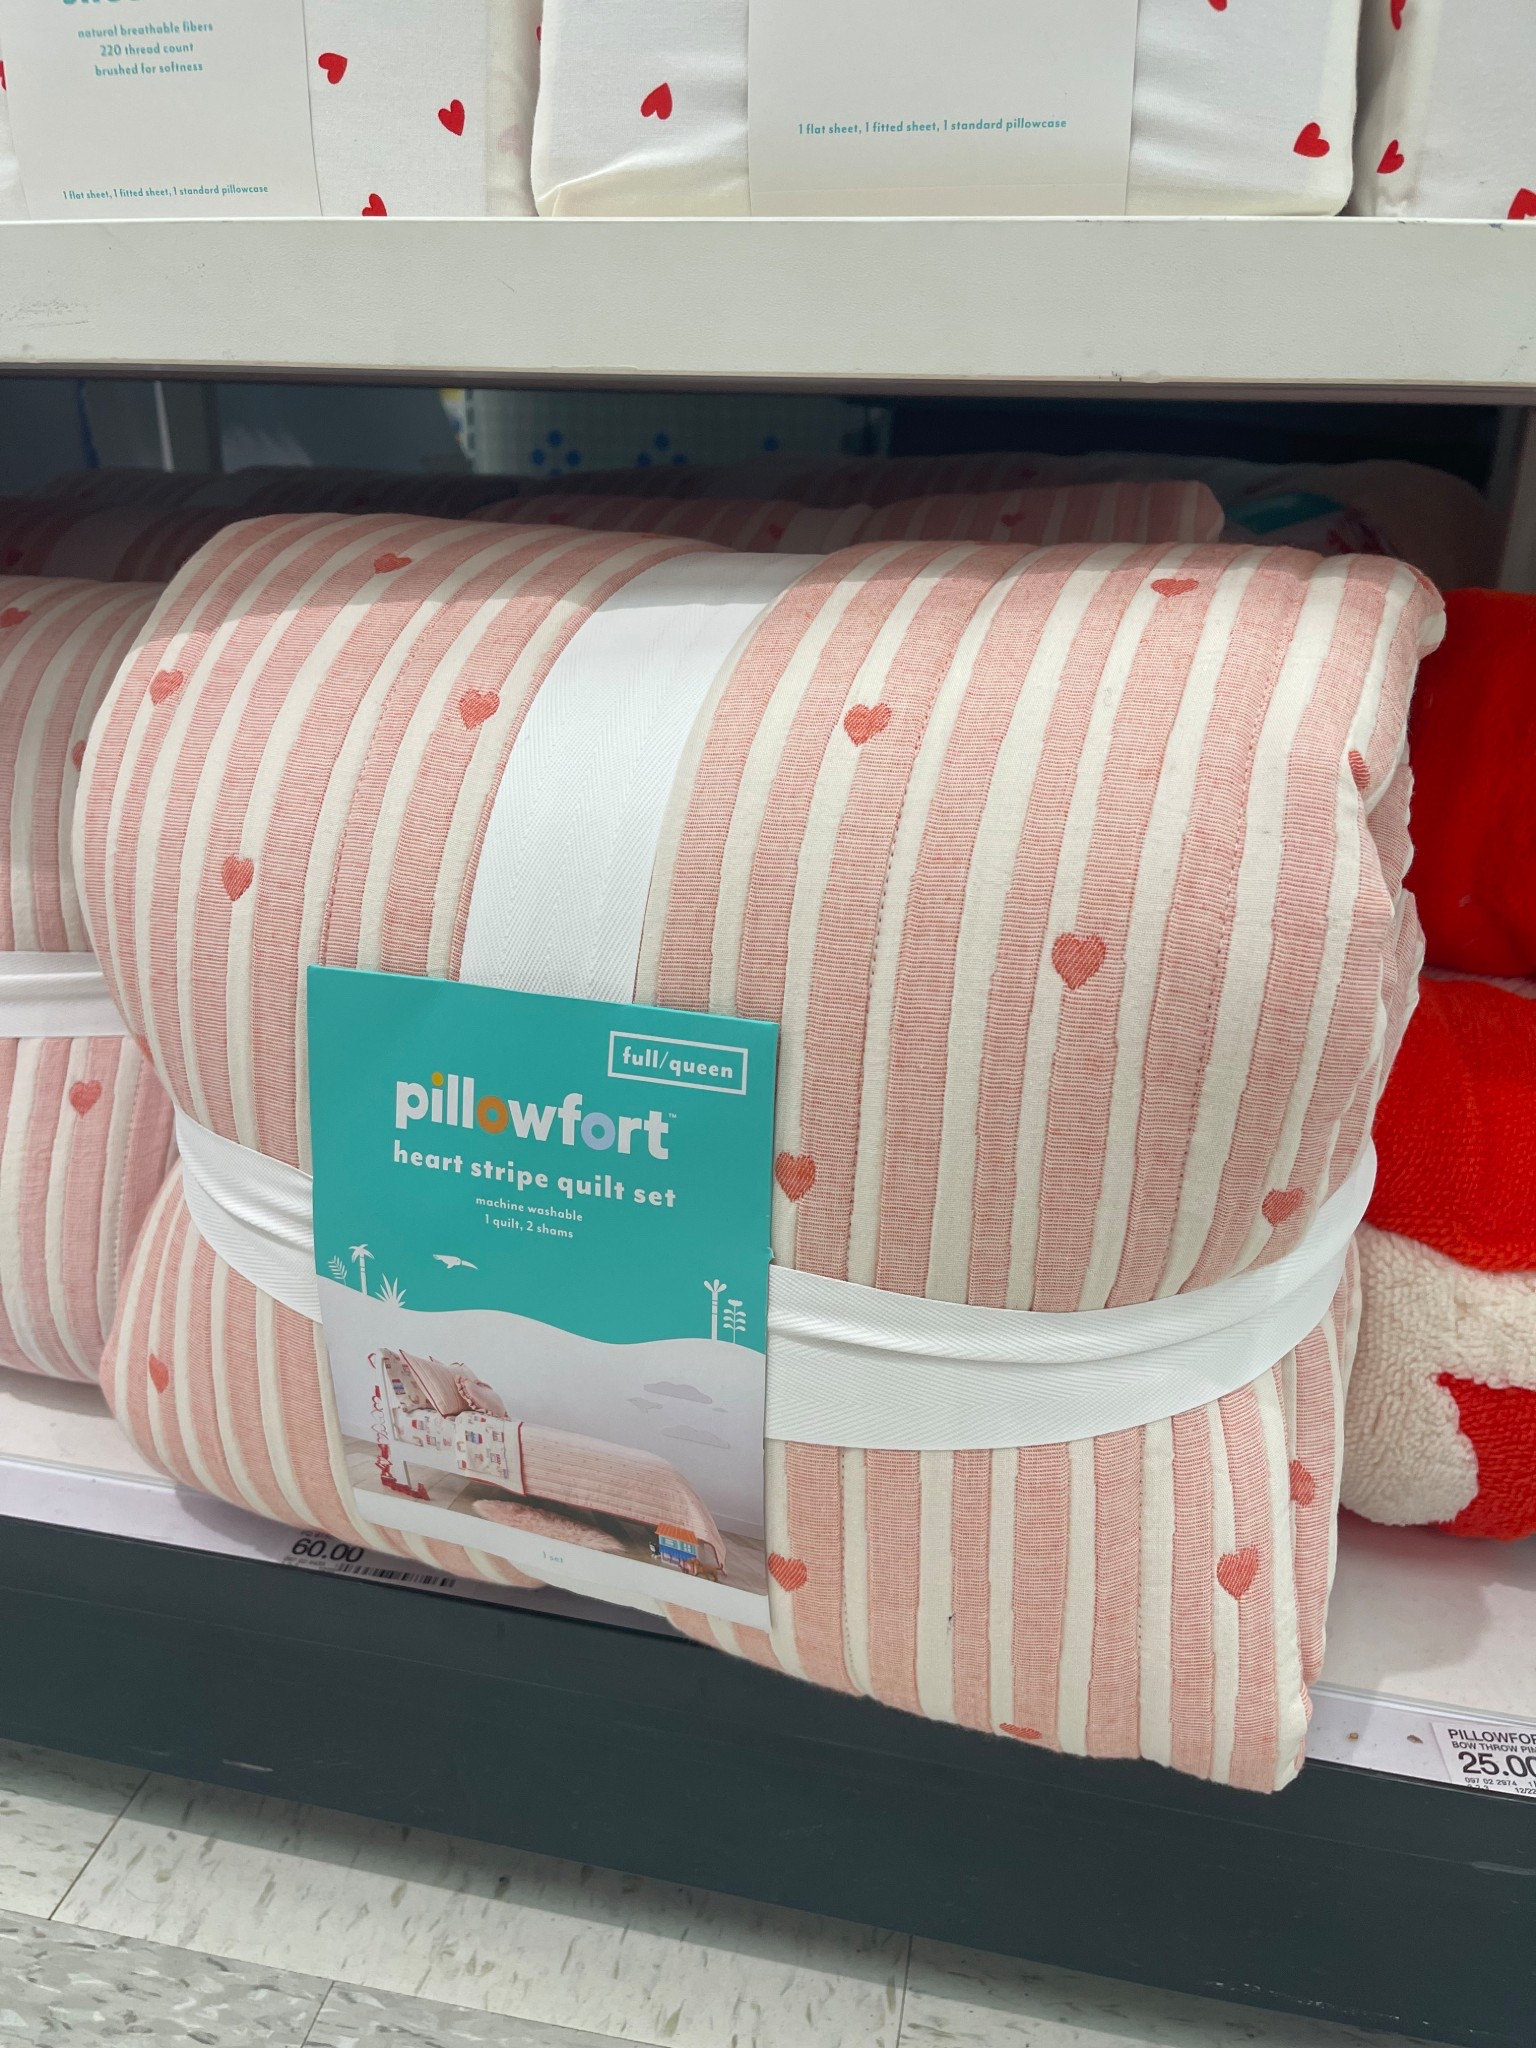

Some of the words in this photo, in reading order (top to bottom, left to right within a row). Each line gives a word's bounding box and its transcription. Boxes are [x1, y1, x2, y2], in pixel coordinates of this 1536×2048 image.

[78, 25, 117, 38] natural
[120, 21, 180, 36] breathable
[183, 20, 213, 33] fibers
[100, 44, 122, 57] 220
[125, 42, 161, 55] thread
[163, 42, 194, 53] count
[95, 63, 138, 76] brushed
[141, 62, 156, 74] for
[159, 61, 203, 73] softness
[806, 123, 826, 134] flat
[828, 122, 862, 135] sheet,
[872, 121, 904, 133] fitted
[906, 120, 940, 133] sheet,
[950, 118, 1002, 130] standard
[1006, 117, 1067, 132] pillowcase
[69, 190, 84, 200] flat
[86, 189, 112, 199] sheet,
[119, 188, 143, 198] fitted
[145, 187, 172, 197] sheet,
[179, 185, 220, 196] standard
[222, 184, 269, 197] pillowcase
[622, 1046, 734, 1079] full/queen
[394, 1139, 463, 1174] heart
[471, 1160, 549, 1191] stripe
[557, 1174, 625, 1199] quilt
[633, 1188, 676, 1208] set
[475, 1197, 525, 1212] machine
[527, 1203, 583, 1222] washable
[484, 1214, 490, 1224] 1
[493, 1217, 523, 1231] quilt,
[526, 1220, 534, 1232] 2
[536, 1224, 574, 1239] shams
[292, 1538, 365, 1563] 60.00
[1452, 1741, 1476, 1750] BOW
[1479, 1743, 1518, 1753] THROW
